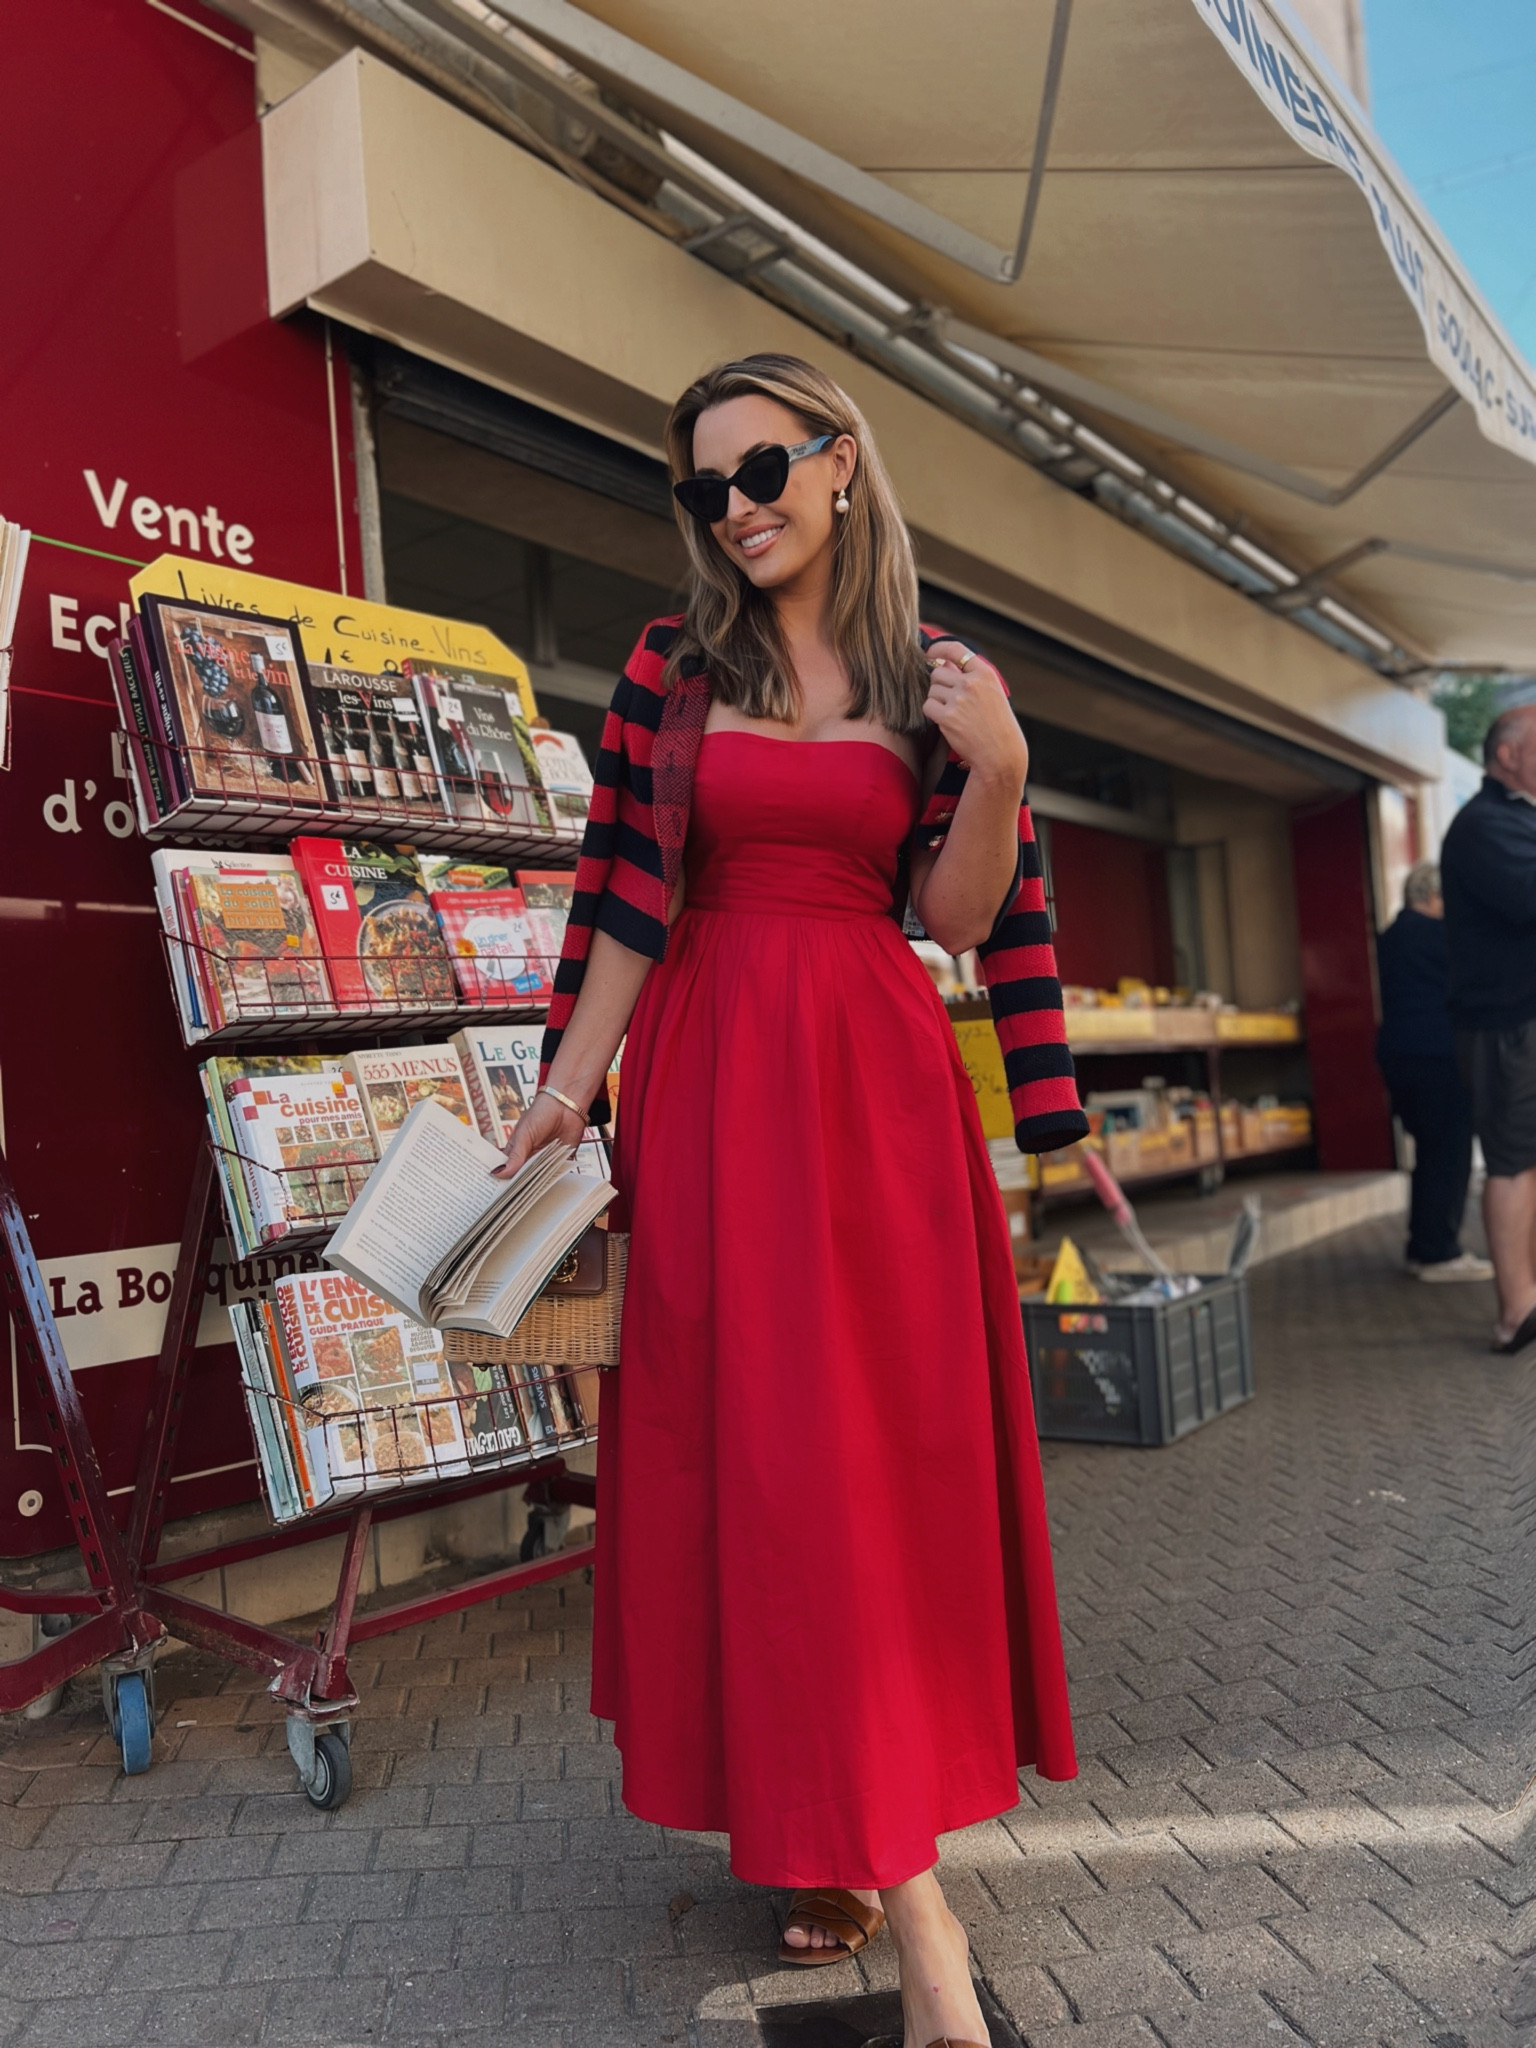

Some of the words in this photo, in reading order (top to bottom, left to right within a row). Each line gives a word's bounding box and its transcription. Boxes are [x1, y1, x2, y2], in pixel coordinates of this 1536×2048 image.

[83, 469, 254, 565] Vente
[288, 605, 316, 628] de
[197, 642, 250, 667] vigne
[120, 652, 140, 700] BACCHUS
[263, 664, 291, 687] vin
[323, 671, 398, 693] LAROUSSE
[357, 690, 394, 709] Vins
[340, 846, 363, 859] LA
[323, 863, 388, 880] CUISINE
[477, 1040, 506, 1063] LE
[511, 1039, 539, 1061] GR
[363, 1062, 391, 1081] 555
[392, 1057, 458, 1078] MENUS
[265, 1090, 291, 1105] La
[461, 1051, 495, 1134] MARTIN
[279, 1096, 361, 1118] cuisine
[299, 1115, 321, 1126] pour
[321, 1114, 341, 1123] mes
[343, 1111, 363, 1121] amis
[49, 1276, 104, 1318] La
[304, 1302, 322, 1315] DE
[323, 1293, 401, 1323] CUISI
[280, 1283, 309, 1358] CUISINE
[306, 1314, 324, 1327] LA
[309, 1325, 339, 1336] GUIDE
[340, 1317, 385, 1333] PRATIQUE
